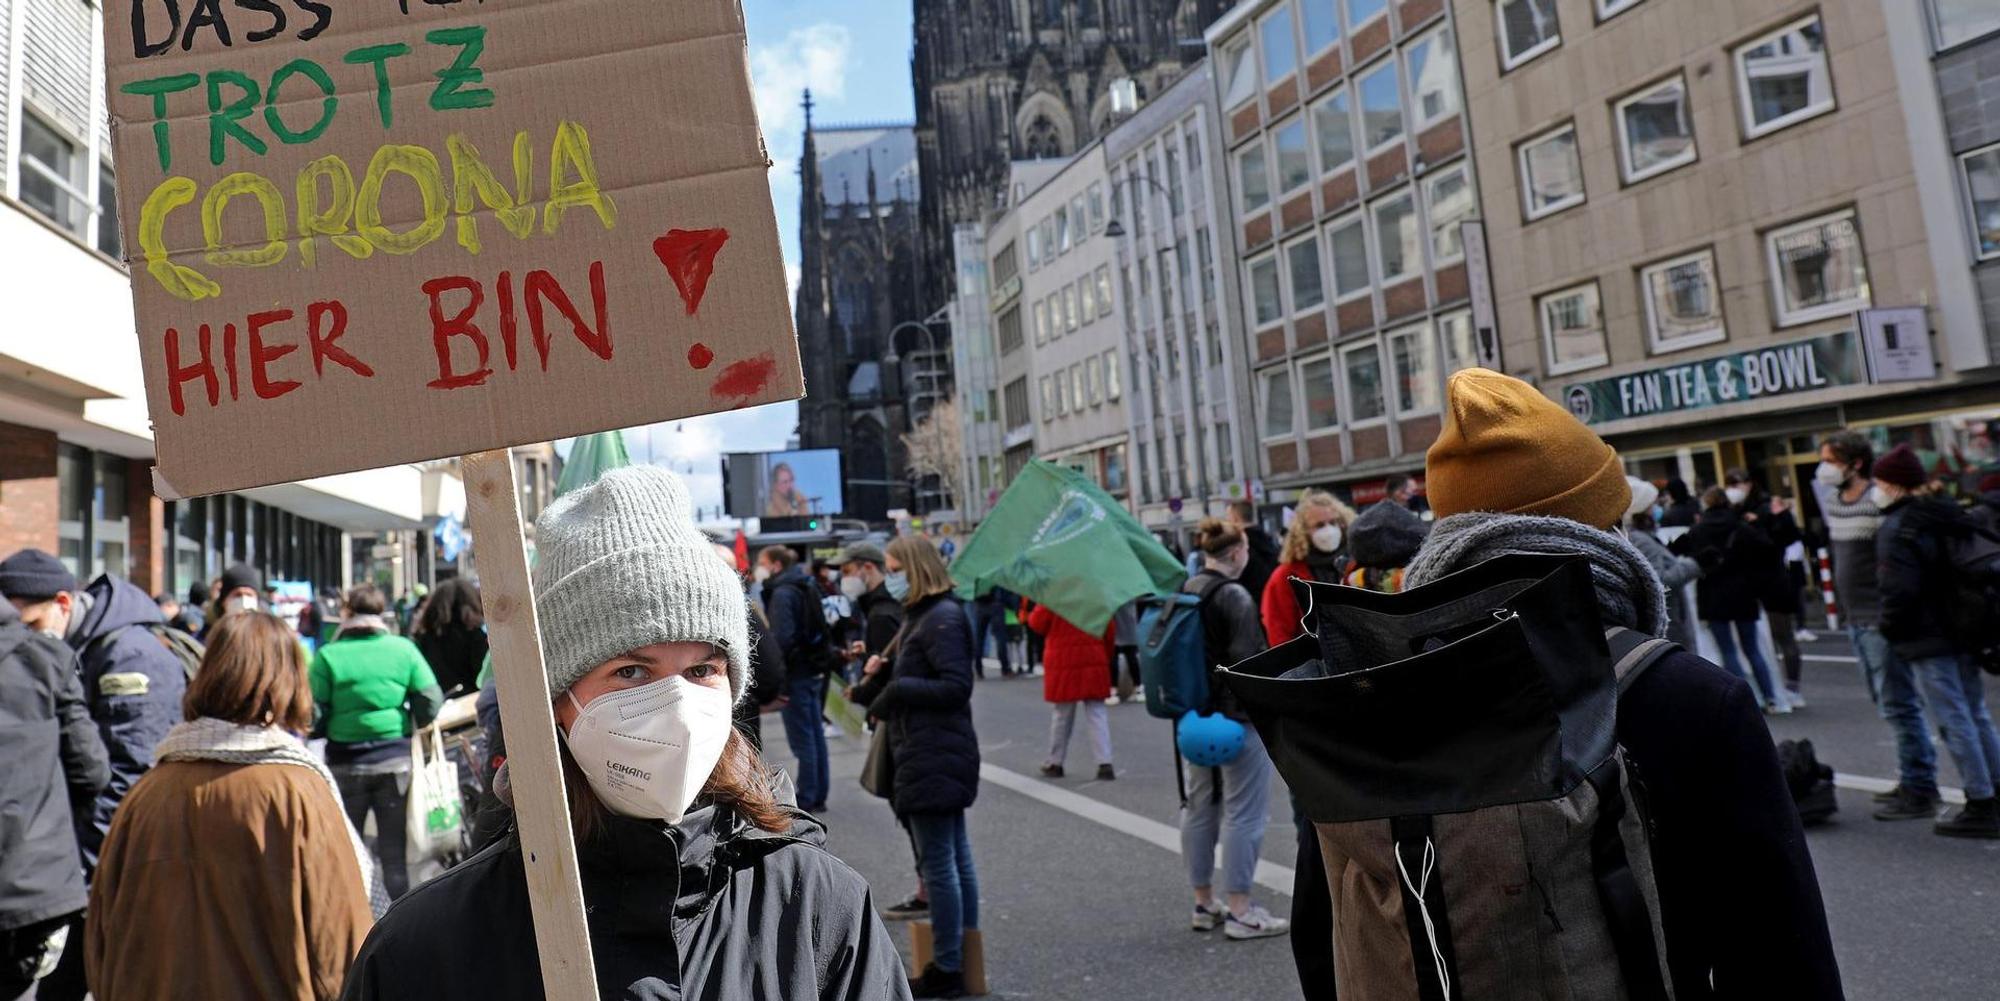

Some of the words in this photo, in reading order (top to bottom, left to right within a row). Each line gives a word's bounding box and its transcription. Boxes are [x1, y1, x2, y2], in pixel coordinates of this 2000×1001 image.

[120, 25, 495, 173] TROTZ
[138, 119, 617, 300] CORONA
[163, 300, 374, 416] HIER
[422, 261, 614, 390] BIN
[1619, 373, 1663, 416] FAN
[1664, 364, 1712, 407] TEA
[1715, 359, 1739, 400] &
[1742, 344, 1826, 395] BOWL
[606, 760, 652, 781] LEIKANG
